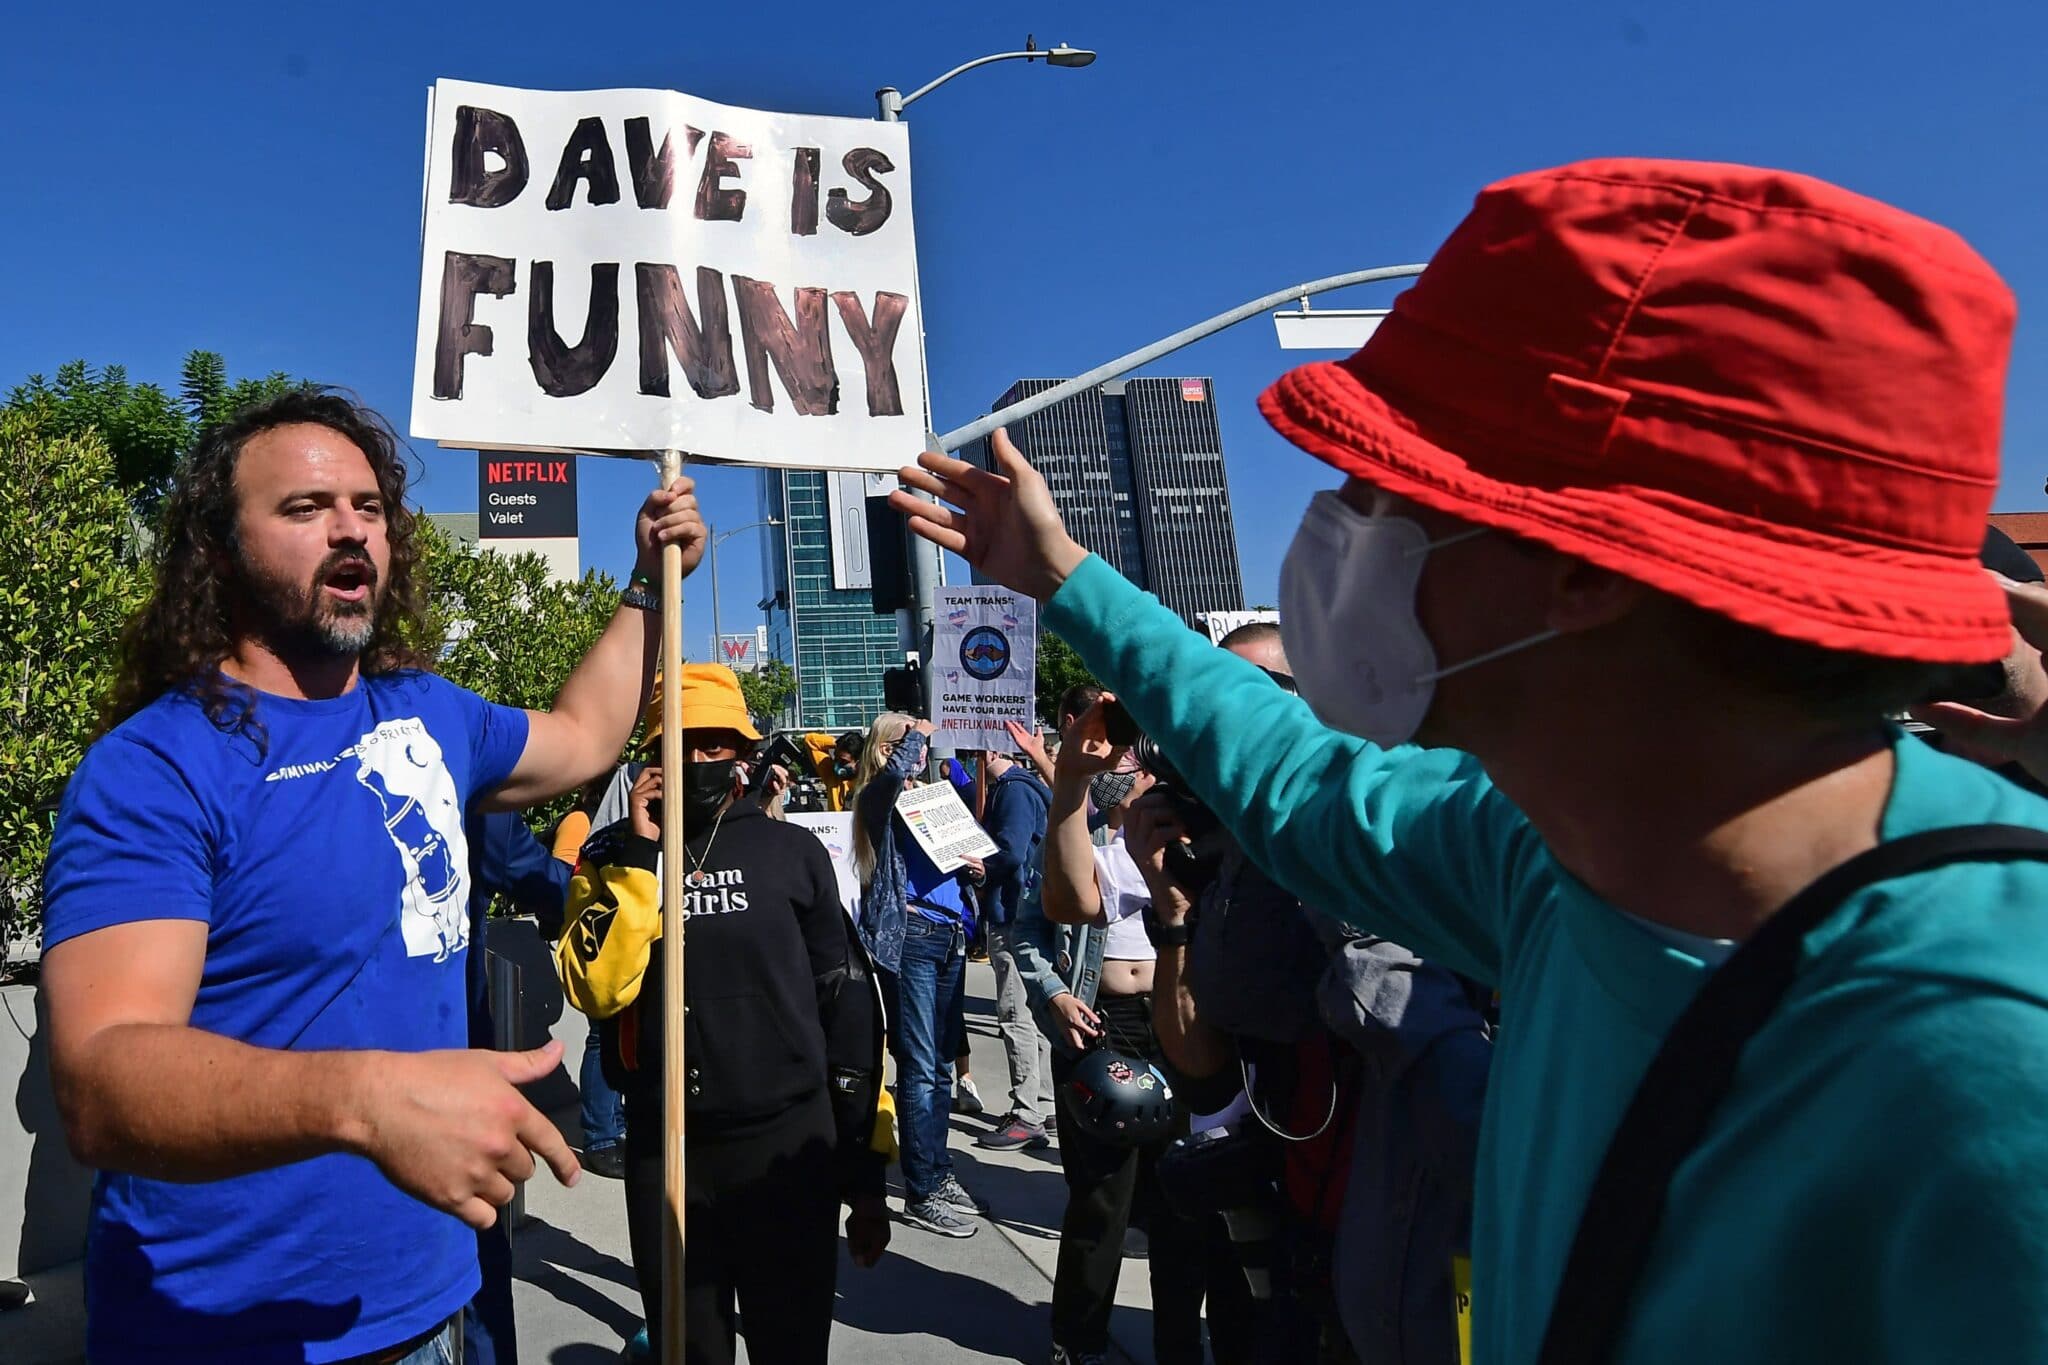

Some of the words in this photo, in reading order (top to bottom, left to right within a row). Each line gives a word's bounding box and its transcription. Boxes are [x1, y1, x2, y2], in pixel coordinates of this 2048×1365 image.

[448, 104, 753, 222] DAVE
[790, 146, 896, 237] IS
[430, 250, 910, 417] FUNNY
[488, 462, 568, 484] NETFLIX
[488, 493, 537, 506] Guests
[489, 511, 524, 524] Valet
[944, 597, 972, 605] TEAM
[723, 640, 749, 659] W
[942, 693, 972, 703] GAME
[974, 694, 1026, 705] WORKERS
[942, 705, 968, 714] HAVE
[969, 706, 995, 715] YOUR
[997, 707, 1025, 716] BACK!
[941, 719, 981, 730] #NETFLIX
[682, 868, 744, 889] eam
